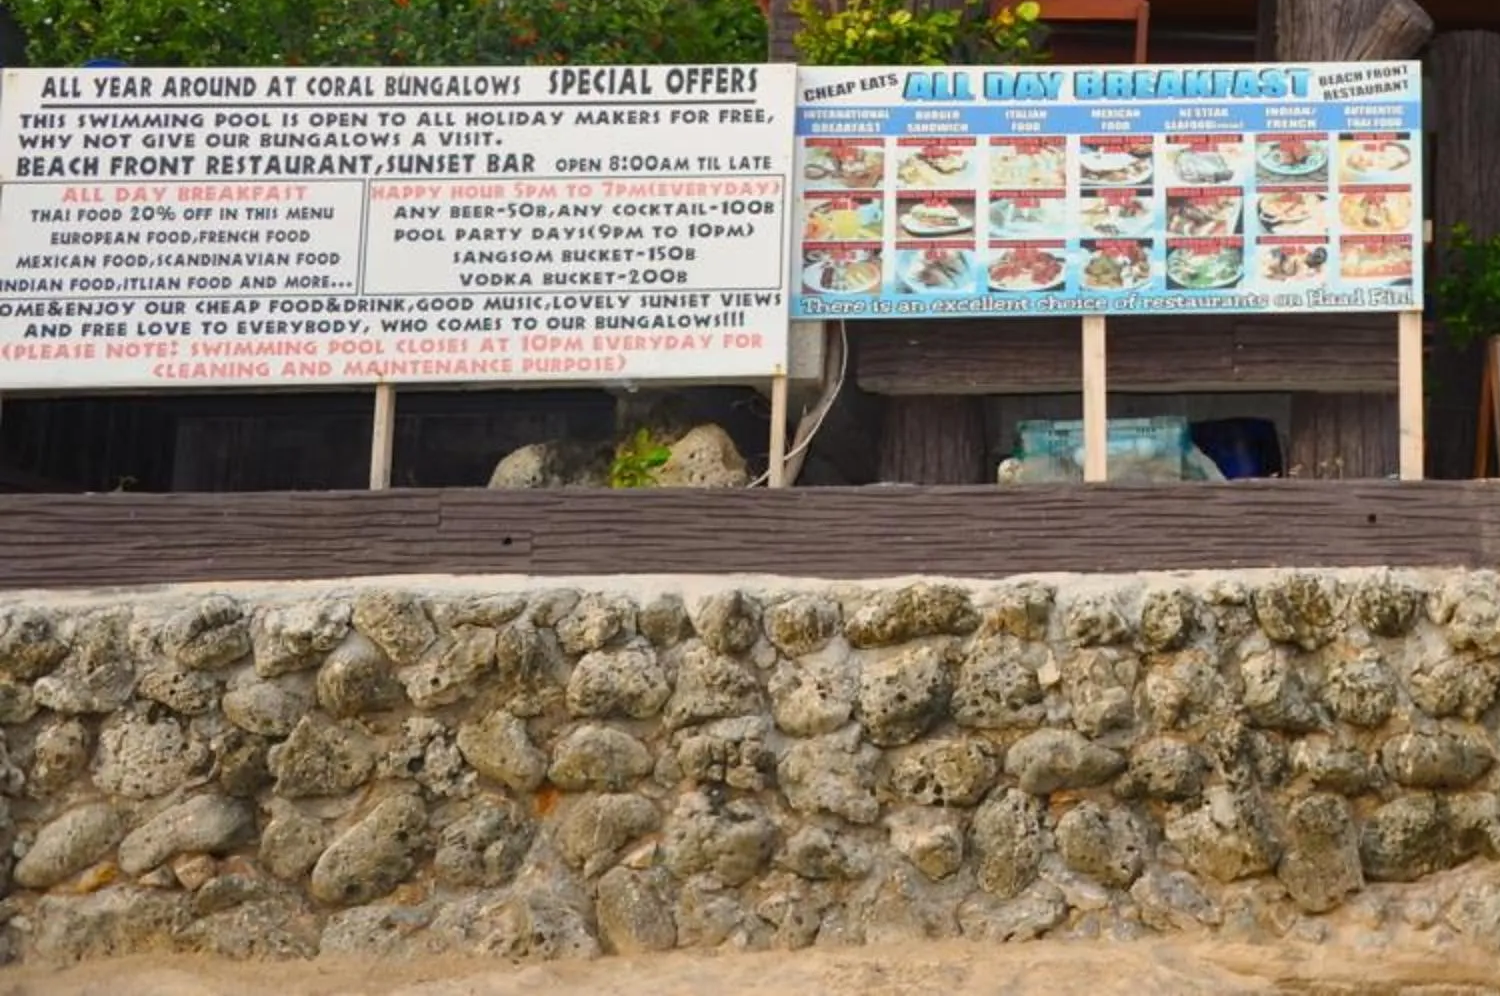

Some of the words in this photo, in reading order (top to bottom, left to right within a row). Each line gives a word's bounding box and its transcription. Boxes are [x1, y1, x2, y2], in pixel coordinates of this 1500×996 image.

[42, 76, 81, 98] ALL
[94, 76, 152, 97] YEAR
[162, 76, 257, 97] AROUND
[266, 75, 296, 97] AT
[307, 75, 374, 97] CORAL
[385, 75, 521, 97] BUNGALOWS
[549, 69, 651, 95] SPECIAL
[666, 68, 758, 93] OFFERS
[903, 71, 976, 100] ALL
[984, 70, 1064, 99] DAY
[1074, 67, 1312, 99] BREAKFAST
[1319, 72, 1363, 86] BEACH
[1367, 65, 1408, 79] FRONT
[804, 82, 856, 101] CHEAP
[861, 74, 898, 91] EATS
[1324, 80, 1408, 100] RESTAURANT
[20, 113, 66, 128] THIS
[78, 113, 203, 128] SWIMMING
[215, 113, 271, 127] POOL
[282, 113, 299, 127] IS
[309, 112, 367, 127] OPEN
[379, 112, 406, 126] TO
[417, 111, 456, 127] ALL
[466, 111, 563, 126] HOLIDAY
[575, 110, 660, 125] MAKERS
[671, 110, 709, 124] FOR
[19, 133, 72, 149] WHY
[84, 134, 132, 149] NOT
[142, 134, 195, 148] GIVE
[206, 134, 250, 148] OUR
[260, 133, 401, 147] BUNGALOWS
[412, 132, 426, 147] A
[439, 132, 502, 146] VISIT.
[16, 157, 98, 177] BEACH
[110, 156, 195, 176] FRONT
[487, 154, 535, 172] BAR
[555, 158, 601, 172] OPEN
[609, 156, 689, 171] 8:00AM
[697, 156, 720, 170] TIL
[729, 156, 771, 170] LATE
[62, 187, 109, 202] ALL
[115, 187, 167, 201] DAY
[178, 186, 307, 200] BREAKFAST
[372, 184, 442, 200] HAPPY
[451, 183, 505, 199] HOUR
[513, 182, 556, 197] 5PM
[565, 183, 593, 197] TO
[31, 209, 71, 222] THAI
[78, 208, 122, 222] FOOD
[130, 207, 176, 222] 20%
[183, 207, 213, 220] OFF
[220, 208, 238, 220] IN
[246, 207, 277, 220] THIS
[286, 207, 334, 220] MENU
[394, 205, 440, 219] ANY
[51, 230, 140, 245] EUROPEAN
[266, 229, 310, 242] FOOD
[394, 227, 444, 242] POOL
[456, 227, 522, 241] PARTY
[653, 225, 677, 239] TO
[16, 255, 96, 269] MEXICAN
[296, 252, 340, 265] FOOD
[454, 248, 553, 264] SANGSOM
[0, 279, 62, 292] INDIAN
[188, 276, 232, 290] FOOD
[240, 276, 276, 289] AND
[460, 272, 532, 287] VODKA
[145, 301, 186, 315] OUR
[196, 300, 260, 314] CHEAP
[640, 294, 709, 307] SUNSET
[720, 293, 781, 306] VIEWS
[803, 298, 866, 314] There
[872, 299, 891, 313] is
[898, 301, 925, 313] an
[927, 296, 1028, 312] excellent
[1036, 295, 1111, 312] choice
[1115, 292, 1139, 310] of
[1141, 293, 1269, 308] restaurants
[25, 323, 72, 337] AND
[81, 322, 127, 336] FREE
[138, 321, 191, 335] LOVE
[201, 322, 227, 335] TO
[382, 318, 428, 332] WHO
[439, 317, 501, 331] COMES
[512, 317, 537, 331] TO
[547, 316, 585, 330] OUR
[191, 340, 317, 356] SWIMMING
[328, 339, 385, 354] POOL
[395, 337, 468, 354] CLOSES
[480, 337, 509, 352] AT
[521, 336, 583, 351] 10PM
[592, 335, 713, 350] EVERYDAY
[723, 334, 762, 349] FOR
[154, 363, 270, 379] CLEANING
[281, 362, 332, 376] AND
[344, 359, 512, 377] MAINTENANCE
